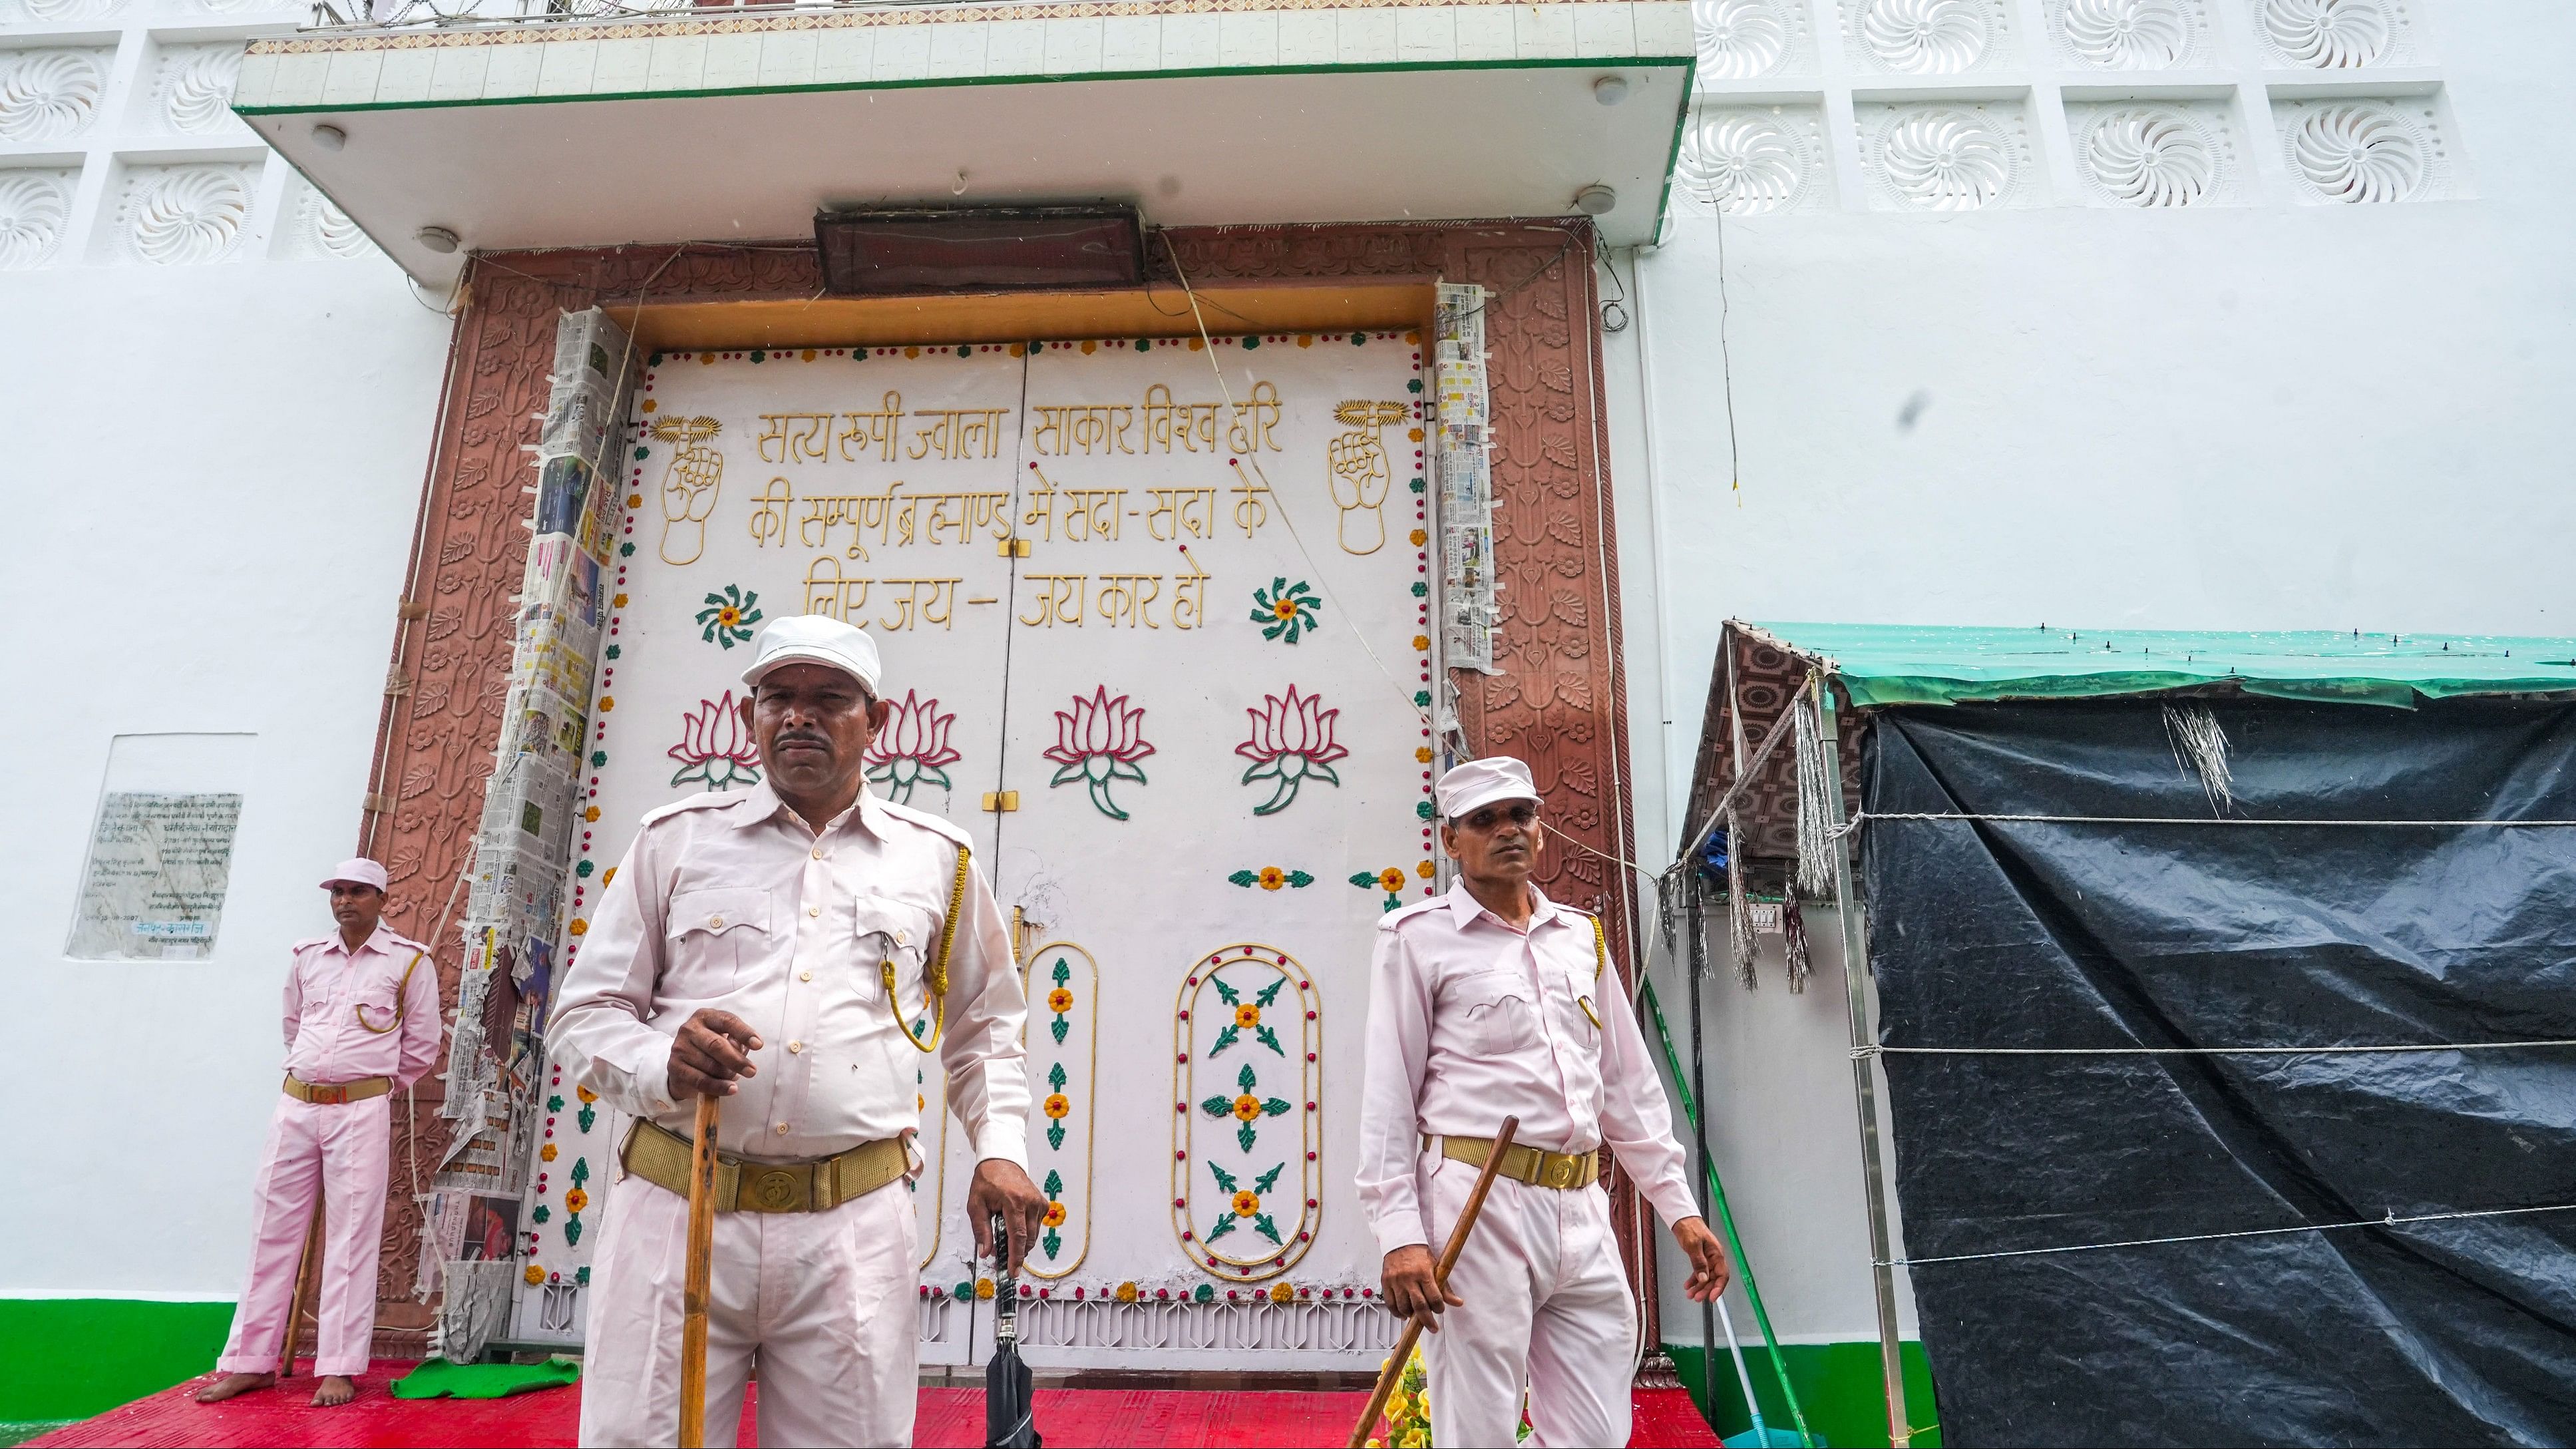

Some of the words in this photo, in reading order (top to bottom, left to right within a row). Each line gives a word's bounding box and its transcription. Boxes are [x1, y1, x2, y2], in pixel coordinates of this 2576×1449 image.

[758, 413, 836, 464] सत्य
[838, 390, 905, 462] रूपी
[906, 408, 1010, 460] ज्वाला
[1032, 404, 1135, 455] साकार
[1141, 383, 1222, 454] विश्व
[1226, 381, 1283, 454] हरि
[749, 477, 795, 548] की
[800, 480, 904, 562] सम्पूर्ण
[1023, 461, 1058, 542] में
[1228, 457, 1270, 538] के
[802, 554, 876, 631] लिए
[879, 577, 963, 631] जय
[1019, 574, 1088, 629] जय
[1096, 573, 1163, 629] कार
[1170, 544, 1211, 630] हो
[575, 721, 584, 751] TOREX
